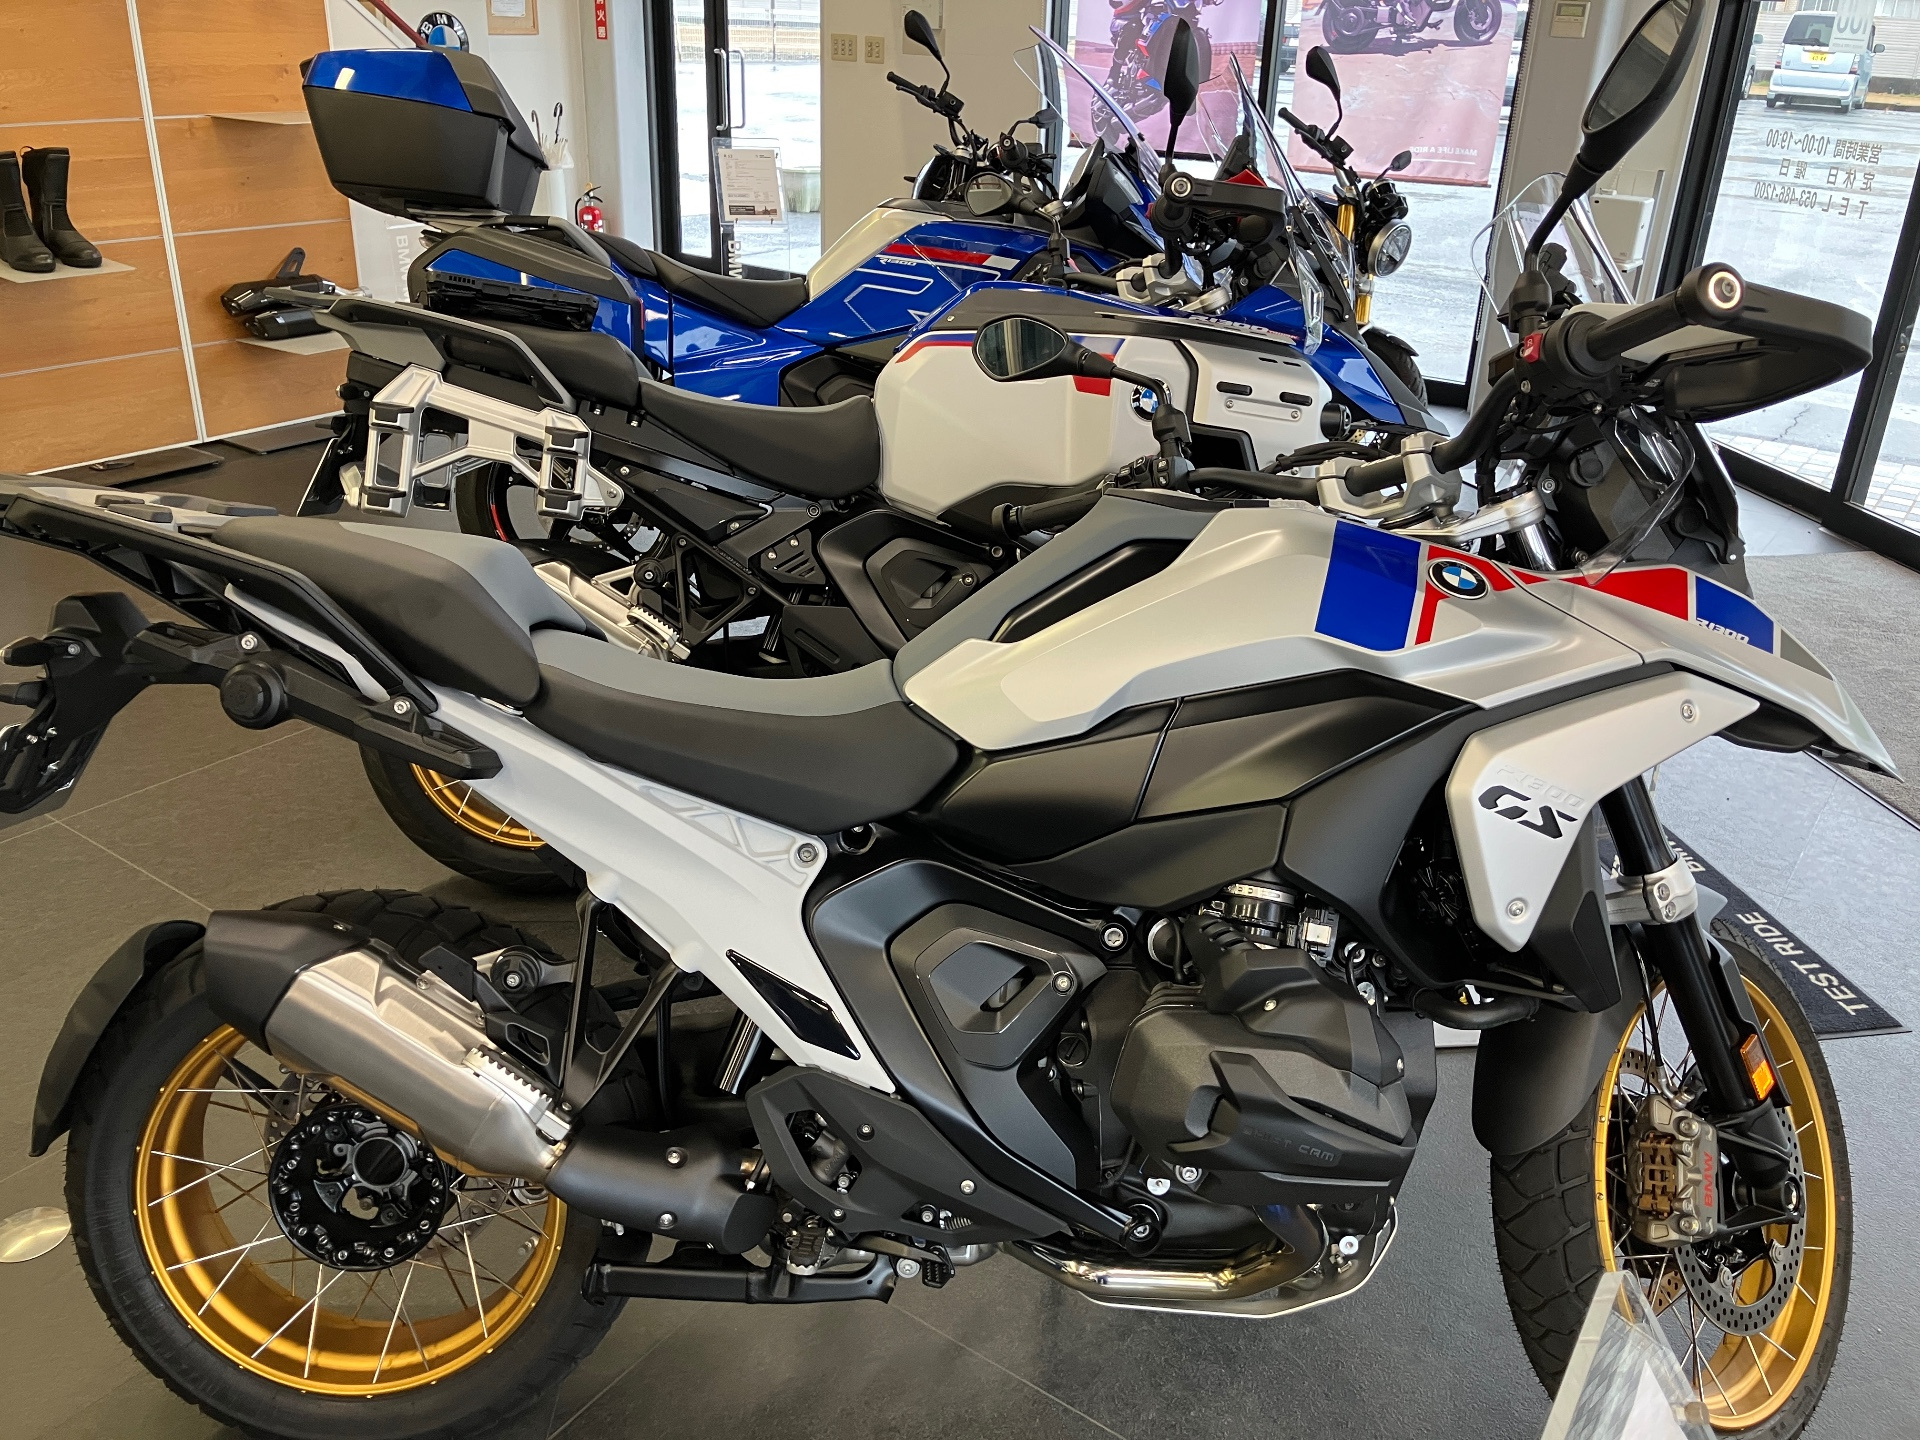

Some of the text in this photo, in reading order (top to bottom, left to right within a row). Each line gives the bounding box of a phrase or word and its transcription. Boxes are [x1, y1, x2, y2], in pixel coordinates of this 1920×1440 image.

[1478, 785, 1578, 839] GS
[1735, 911, 1869, 1016] TEST RIDE
[1704, 1151, 1713, 1207] BMW
